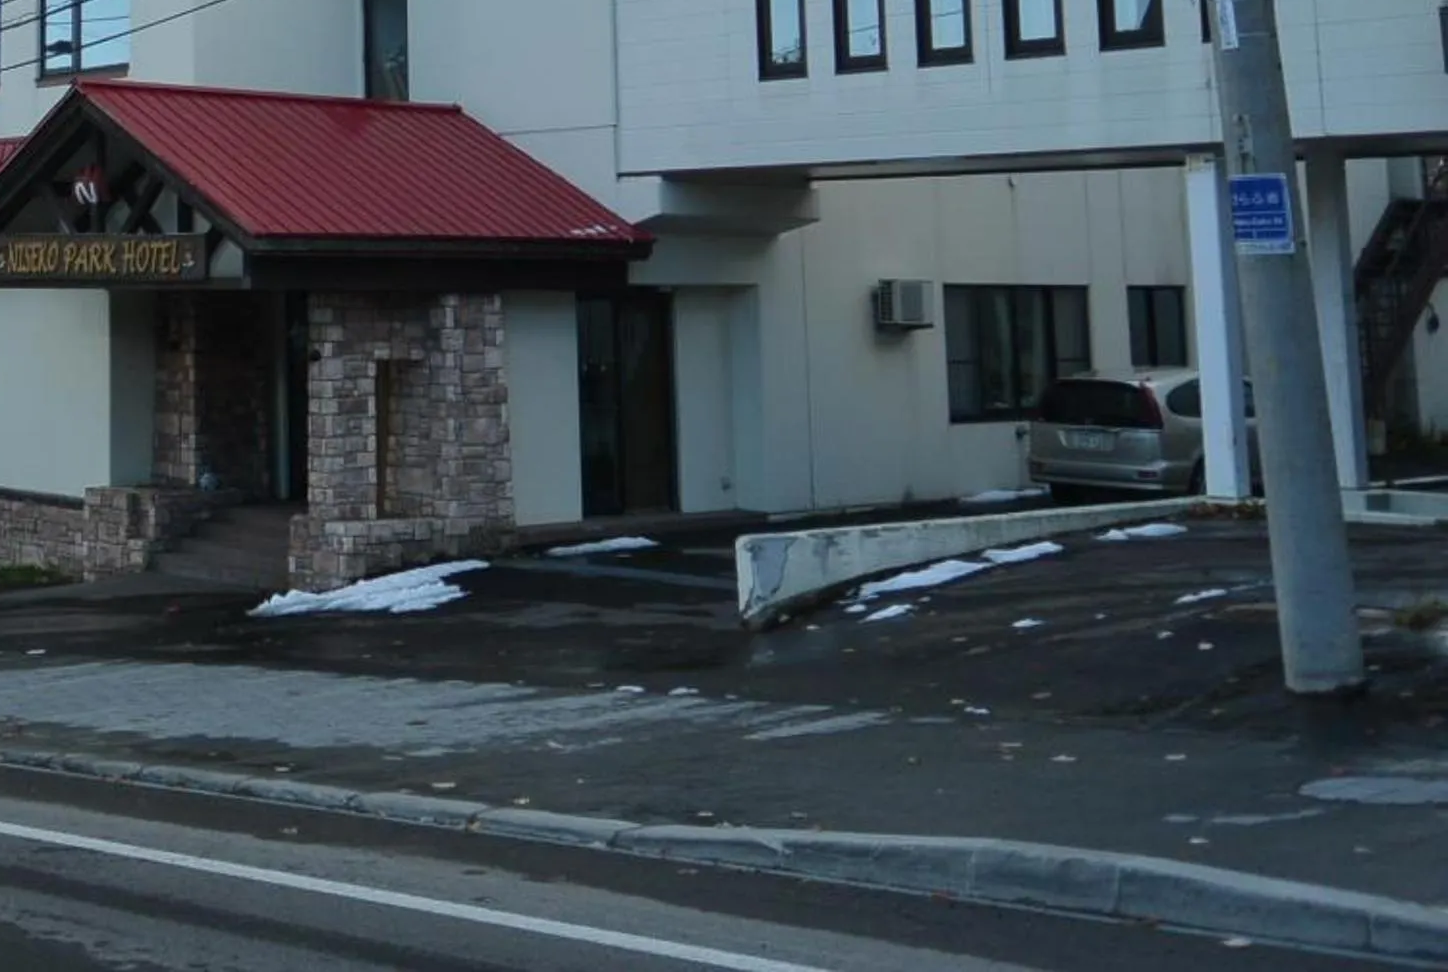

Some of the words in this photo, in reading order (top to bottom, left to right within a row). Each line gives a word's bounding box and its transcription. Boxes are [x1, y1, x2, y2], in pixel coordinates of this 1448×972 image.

[74, 181, 98, 205] N
[7, 241, 59, 274] NISEKO
[63, 241, 117, 274] PARK
[122, 239, 181, 275] HOTEL
